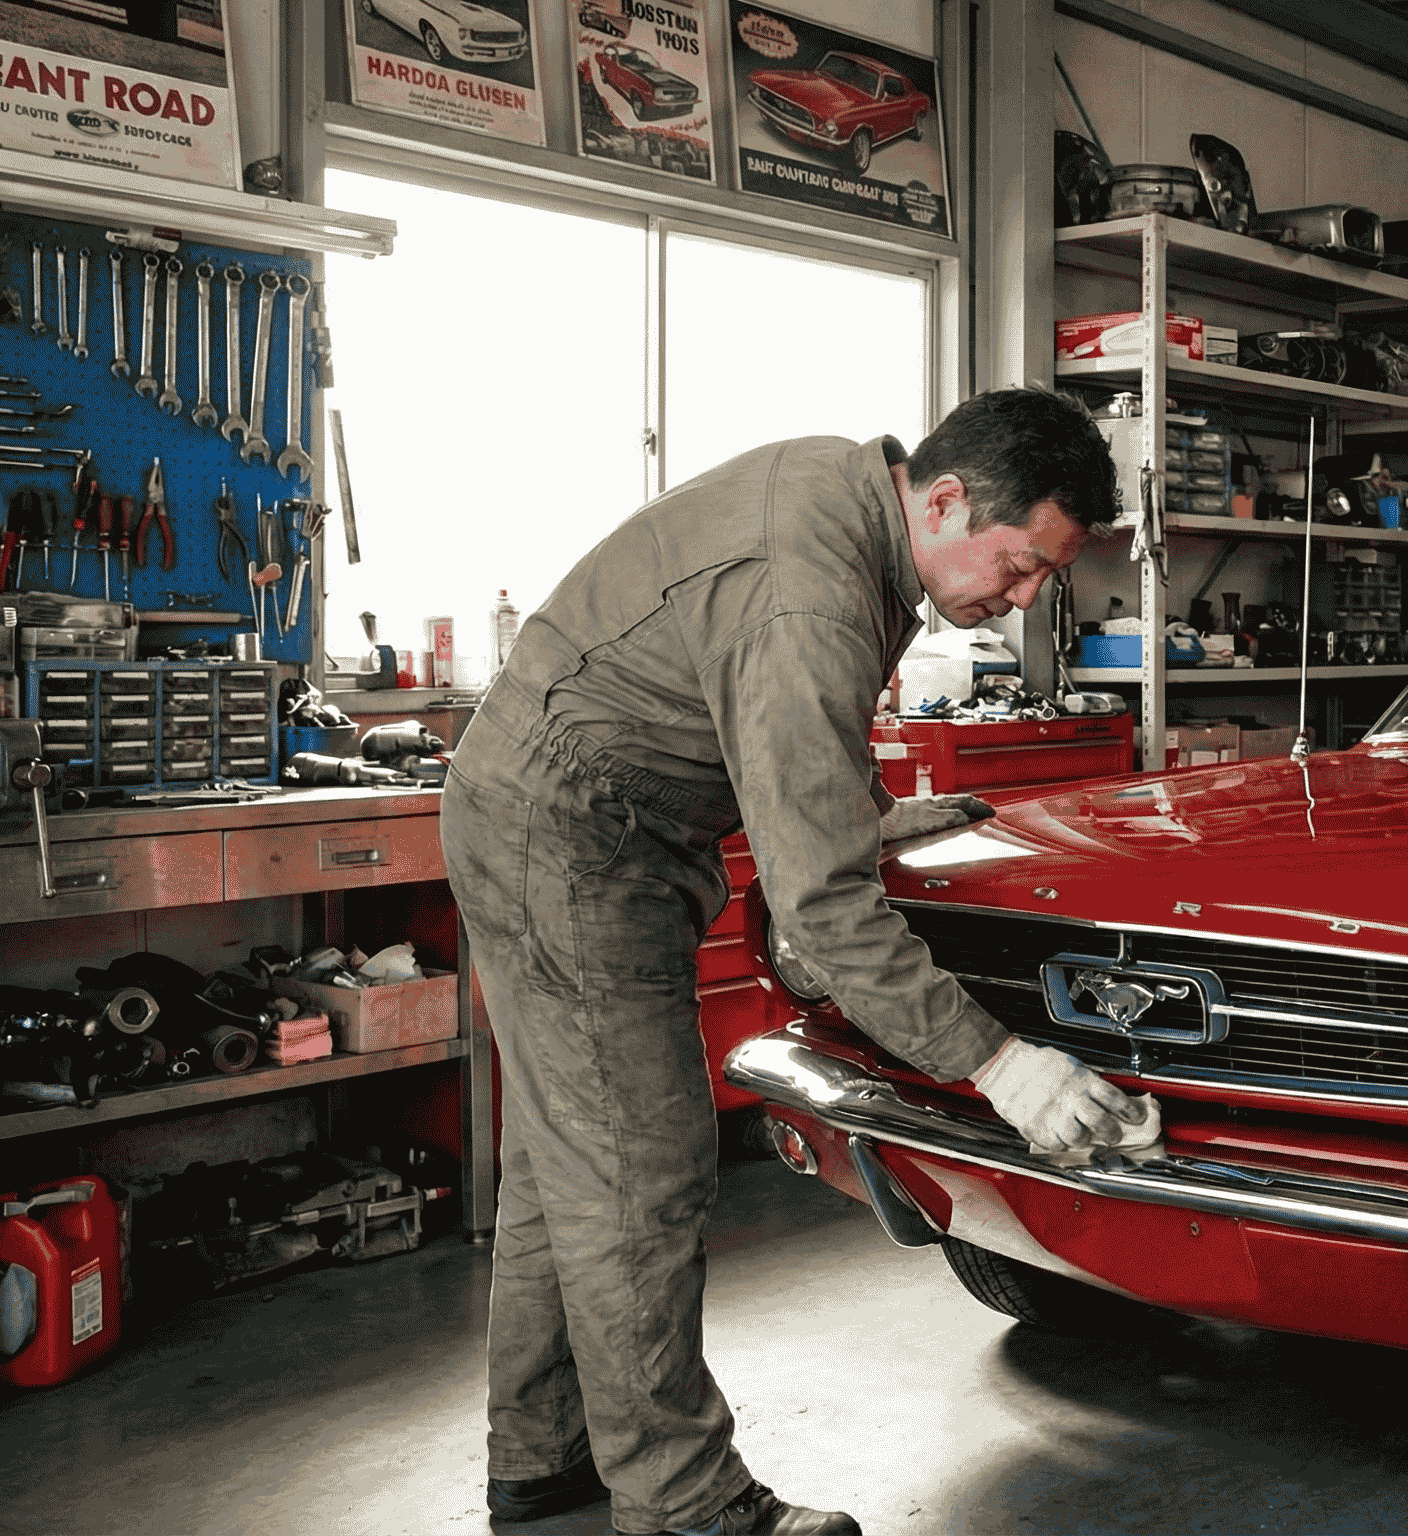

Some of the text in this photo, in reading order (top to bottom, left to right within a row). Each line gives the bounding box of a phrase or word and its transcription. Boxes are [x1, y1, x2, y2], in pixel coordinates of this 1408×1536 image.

[0, 54, 90, 103] ANT
[103, 75, 216, 127] ROAD
[455, 78, 526, 111] GLUSEN
